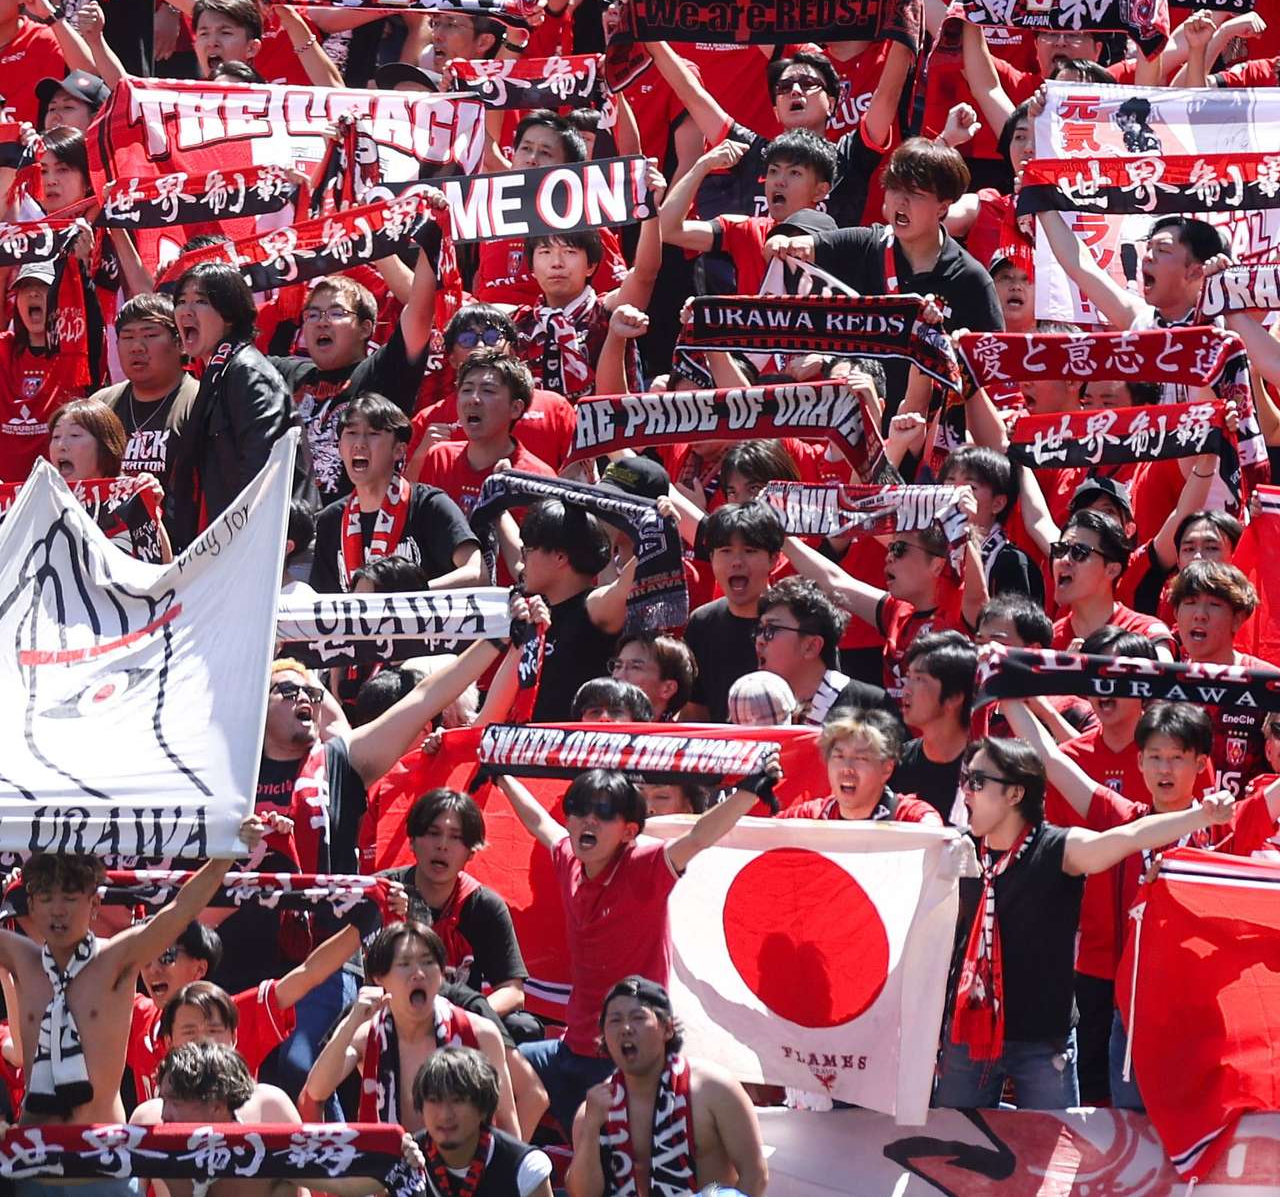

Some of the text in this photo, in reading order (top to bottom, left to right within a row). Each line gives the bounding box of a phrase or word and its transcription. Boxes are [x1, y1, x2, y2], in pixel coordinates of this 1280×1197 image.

[1023, 16, 1050, 25] JAPAN
[103, 166, 290, 223] 世界制覇
[537, 158, 650, 226] ON!
[705, 308, 907, 335] URAWA REDS
[625, 387, 719, 437] PRIDE
[727, 389, 770, 432] OF
[778, 382, 862, 442] URAWA
[1028, 404, 1216, 465] 世界制覇
[174, 506, 252, 574] pray for
[315, 595, 488, 633] URAWA
[1091, 679, 1256, 706] URAWA
[28, 805, 208, 858] URAWA
[783, 1045, 867, 1070] FLAMES
